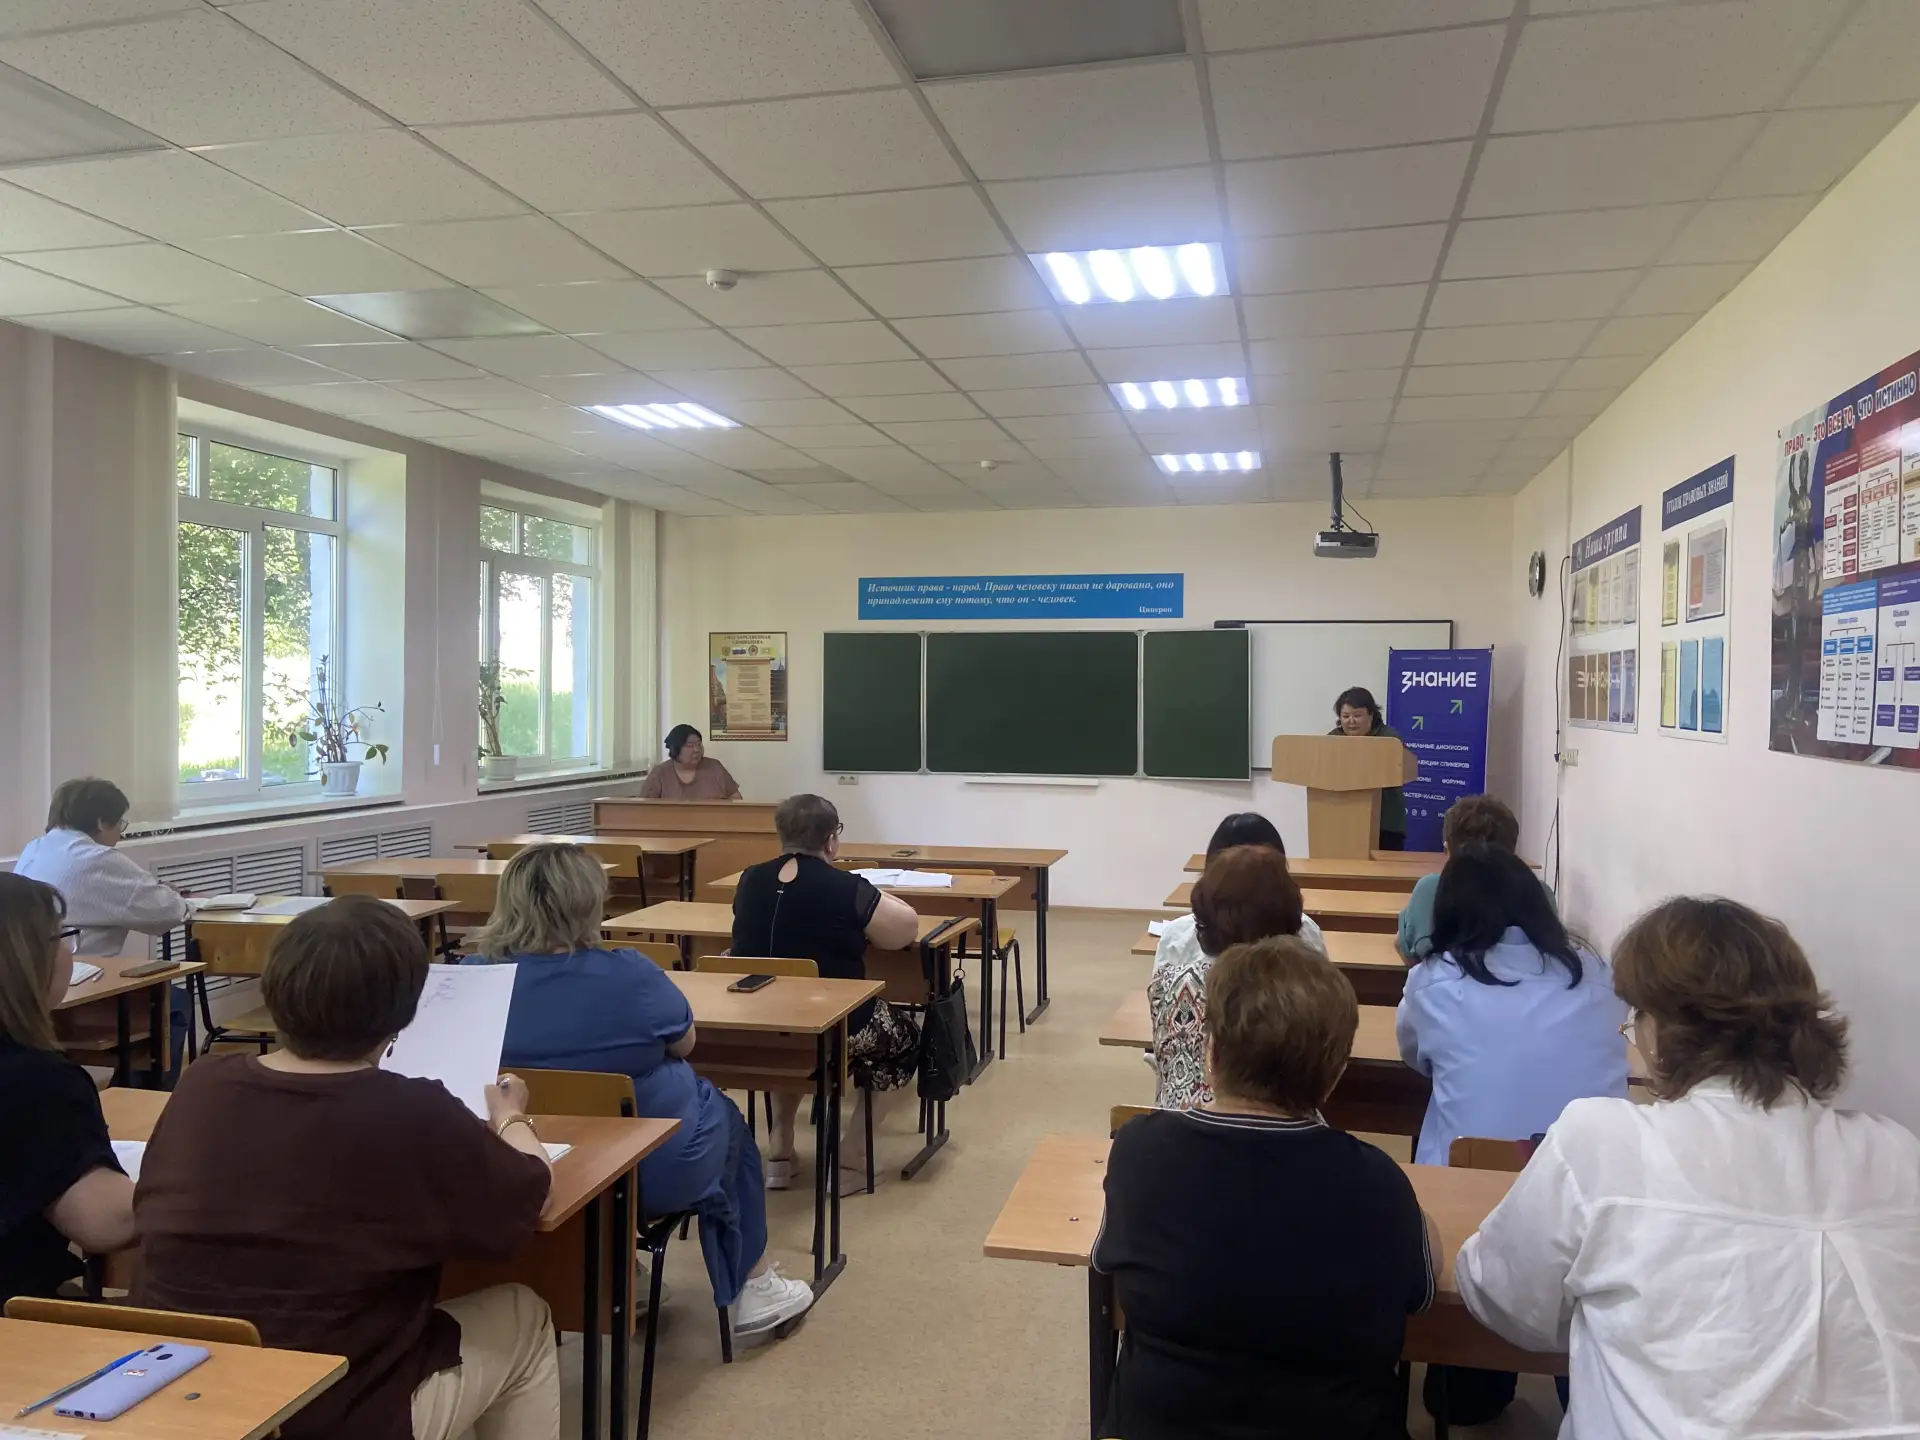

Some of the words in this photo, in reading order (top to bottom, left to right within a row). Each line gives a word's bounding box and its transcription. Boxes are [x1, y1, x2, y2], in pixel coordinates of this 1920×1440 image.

[1784, 433, 1804, 457] ПРАВО
[1813, 422, 1826, 442] ЭТО
[1827, 411, 1842, 437] ВСЕ
[1857, 394, 1873, 420] ЧТО
[1875, 372, 1916, 413] ИСТИННО
[1603, 523, 1628, 555] группа
[867, 583, 915, 593] Источник
[917, 584, 944, 594] права
[952, 582, 982, 592] народ.
[984, 582, 1014, 593] Право
[1016, 583, 1057, 593] человеку
[1091, 582, 1103, 590] не
[1105, 580, 1153, 592] даровано,
[867, 596, 934, 607] принадлежит
[935, 597, 953, 607] ему
[954, 597, 993, 606] потому,
[1017, 596, 1029, 604] он
[1038, 594, 1077, 604] человек.
[1402, 671, 1477, 693] ЗНАНИЕ
